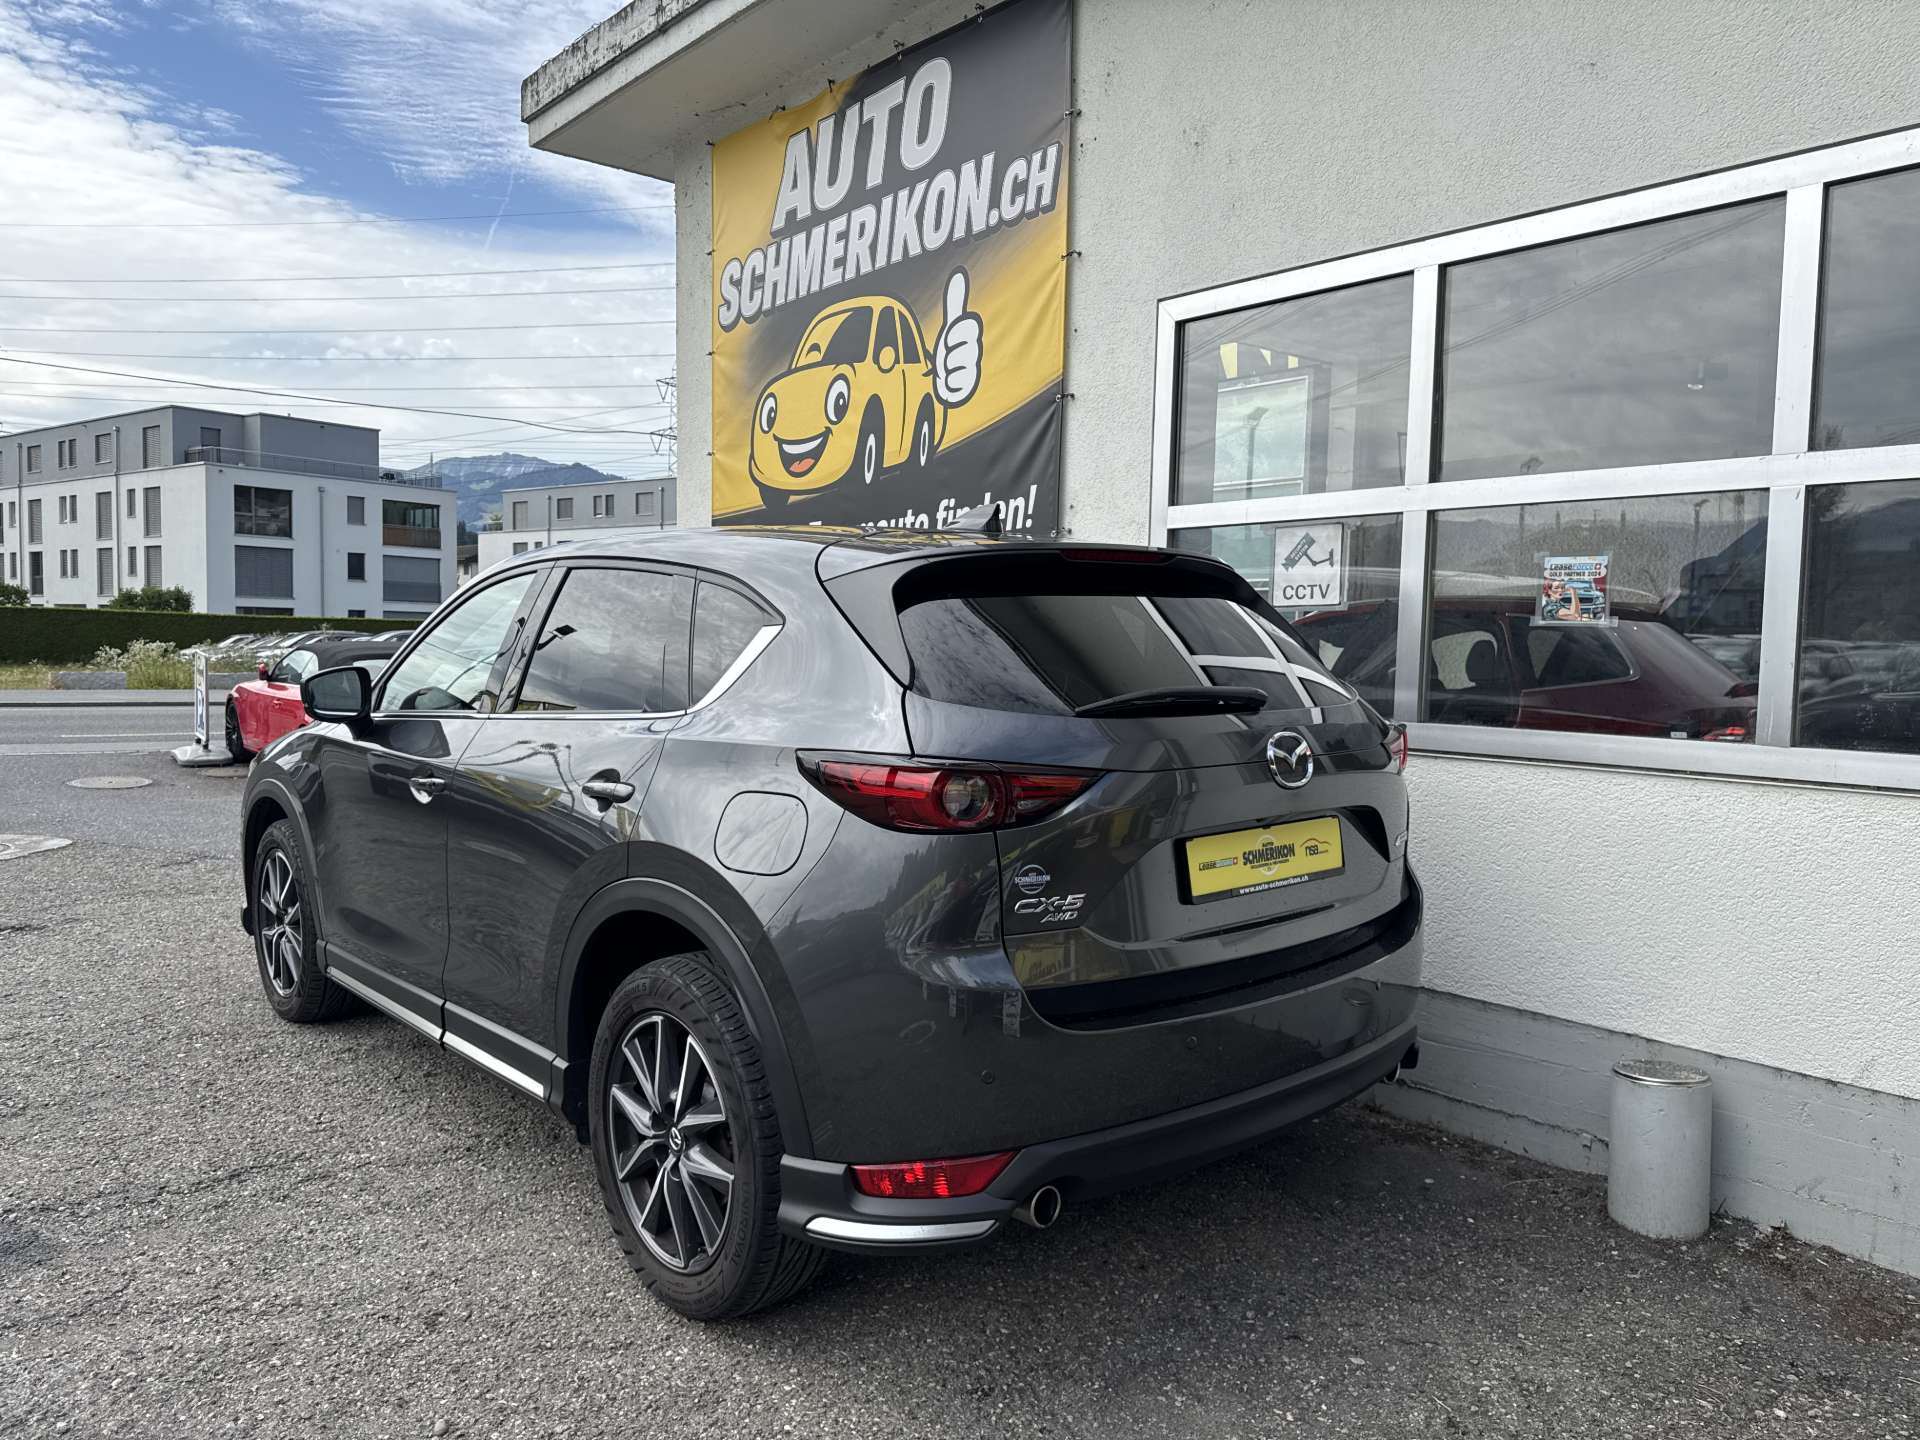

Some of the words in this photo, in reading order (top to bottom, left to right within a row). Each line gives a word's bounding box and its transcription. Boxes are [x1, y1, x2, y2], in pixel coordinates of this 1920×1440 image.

[771, 57, 952, 234] AUTO
[718, 144, 1062, 330] SCHMERIKON.CH
[1283, 583, 1331, 600] CCTV
[1243, 845, 1295, 866] SCHMERIKON
[1014, 893, 1087, 913] CX-5
[1040, 911, 1078, 923] AWD
